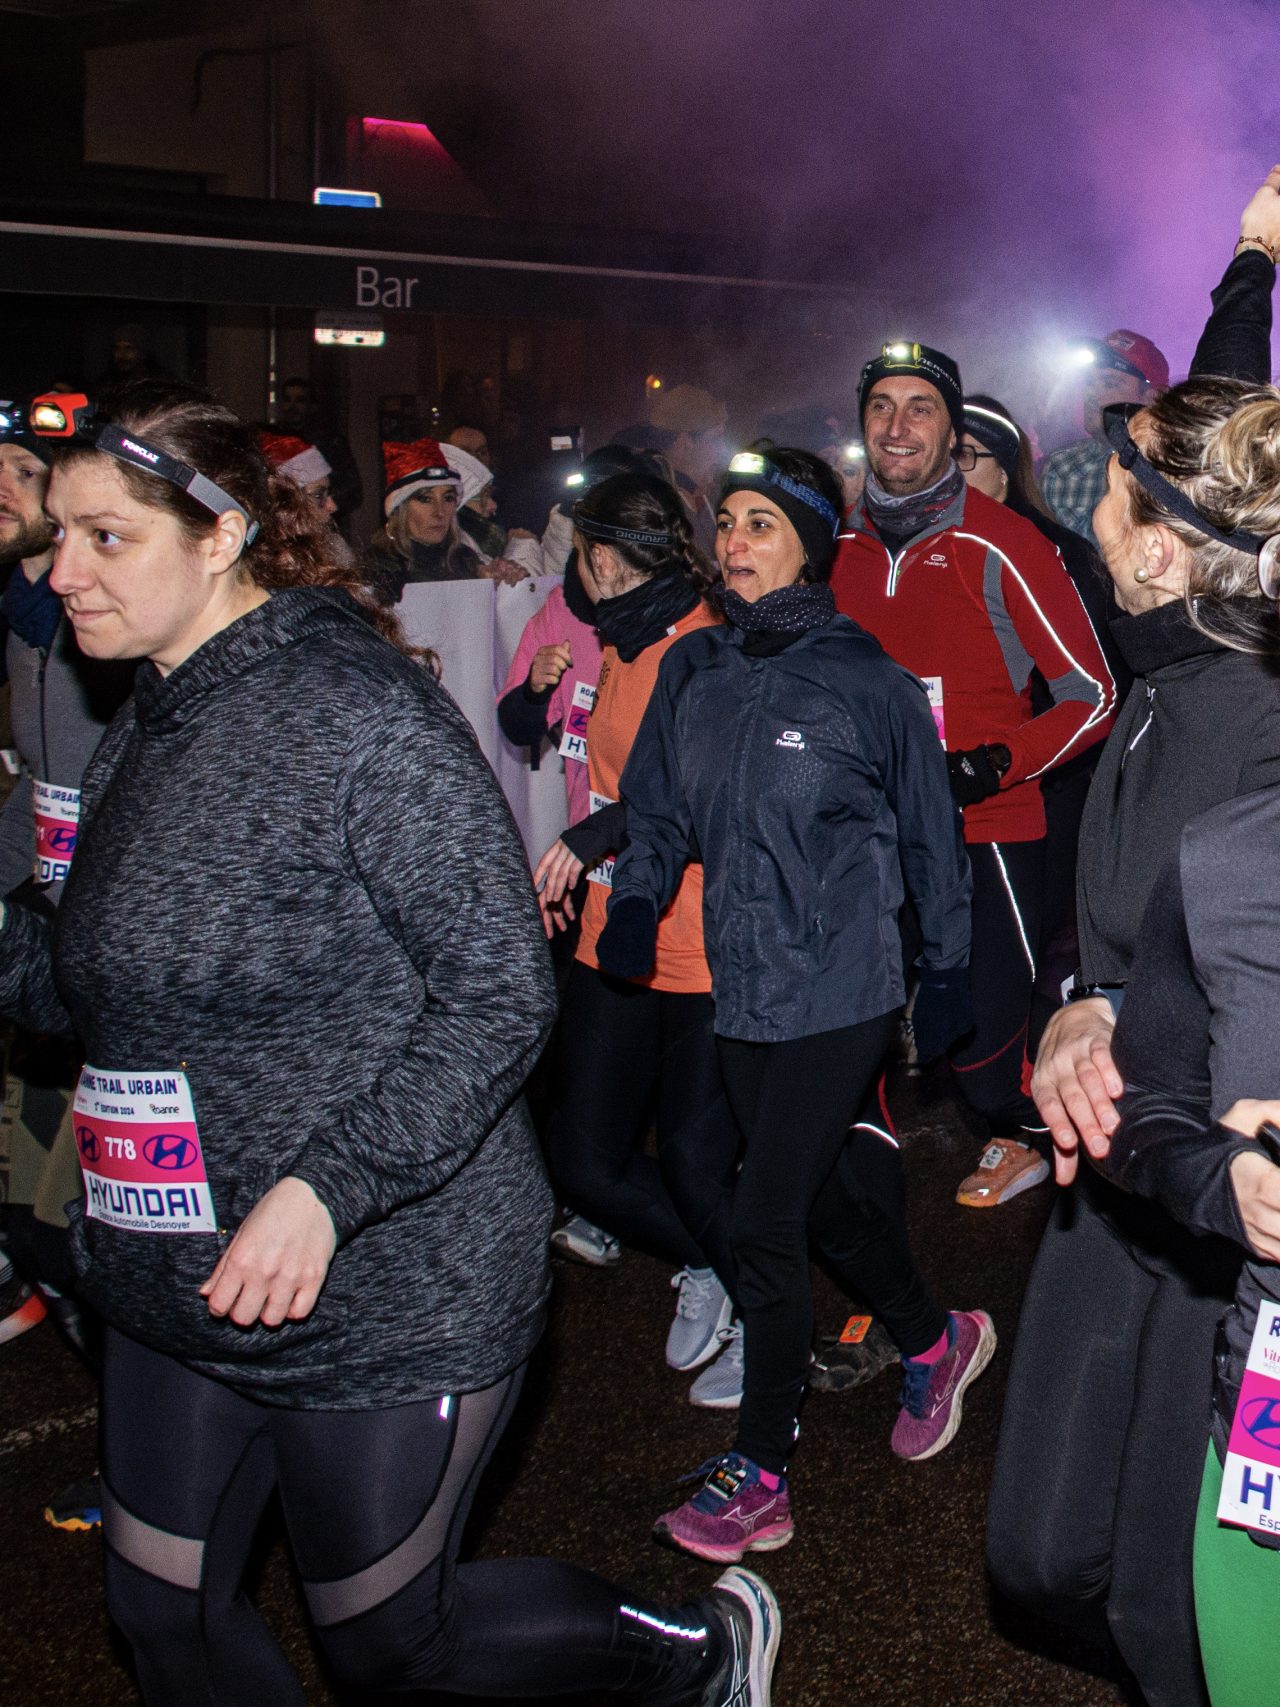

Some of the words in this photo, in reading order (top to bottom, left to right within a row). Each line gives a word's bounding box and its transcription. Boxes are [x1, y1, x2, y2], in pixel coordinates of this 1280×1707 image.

[356, 266, 418, 308] Bar
[616, 530, 668, 544] GRUNDIG
[97, 1077, 125, 1094] TRAIL
[128, 1079, 178, 1095] URBAIN
[104, 1136, 137, 1161] 778
[89, 1175, 201, 1216] HYUNDAI
[151, 1220, 190, 1230] Desnoyer
